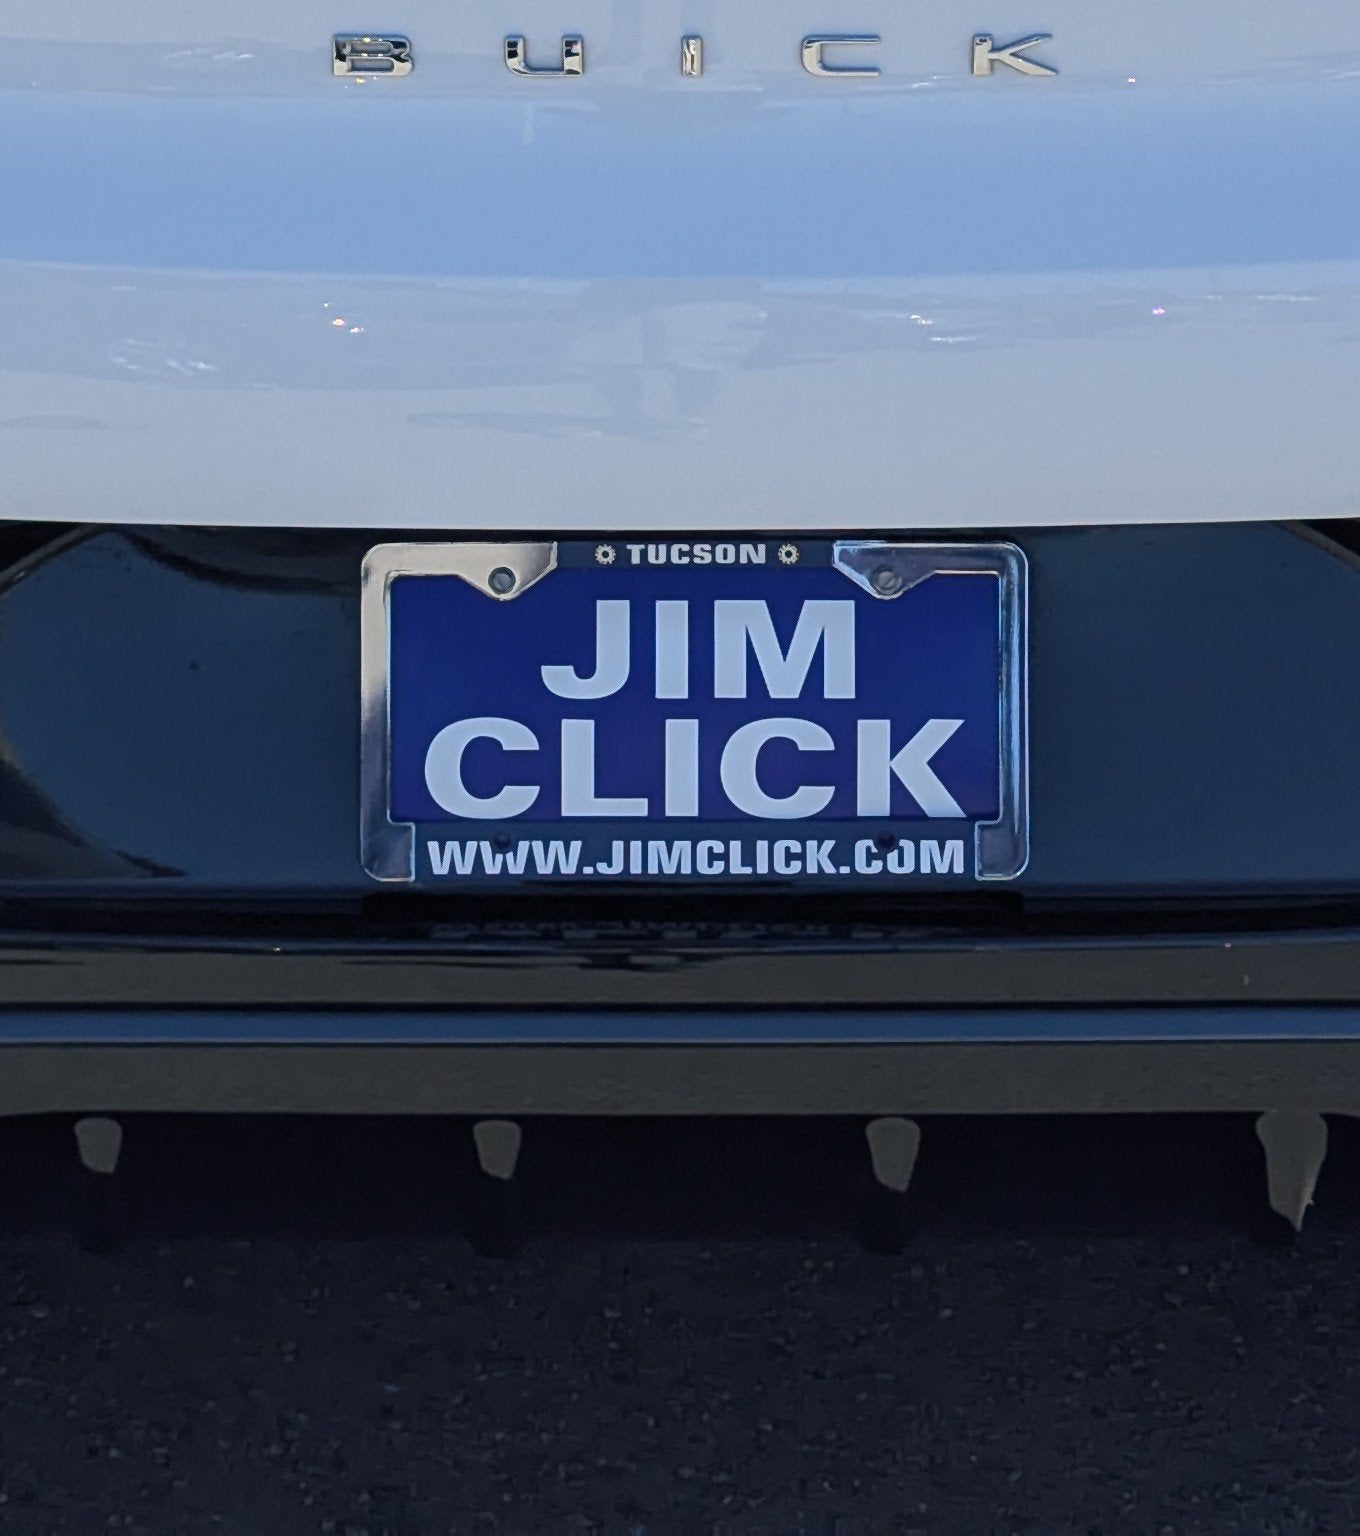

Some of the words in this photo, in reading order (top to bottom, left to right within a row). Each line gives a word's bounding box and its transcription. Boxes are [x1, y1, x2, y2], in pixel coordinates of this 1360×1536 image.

[332, 32, 1059, 78] BUICK
[625, 543, 767, 565] TUCSON
[540, 598, 857, 700] JIM
[423, 716, 968, 820] CLICK
[426, 838, 965, 876] WWW.JIMCLICK.COM
